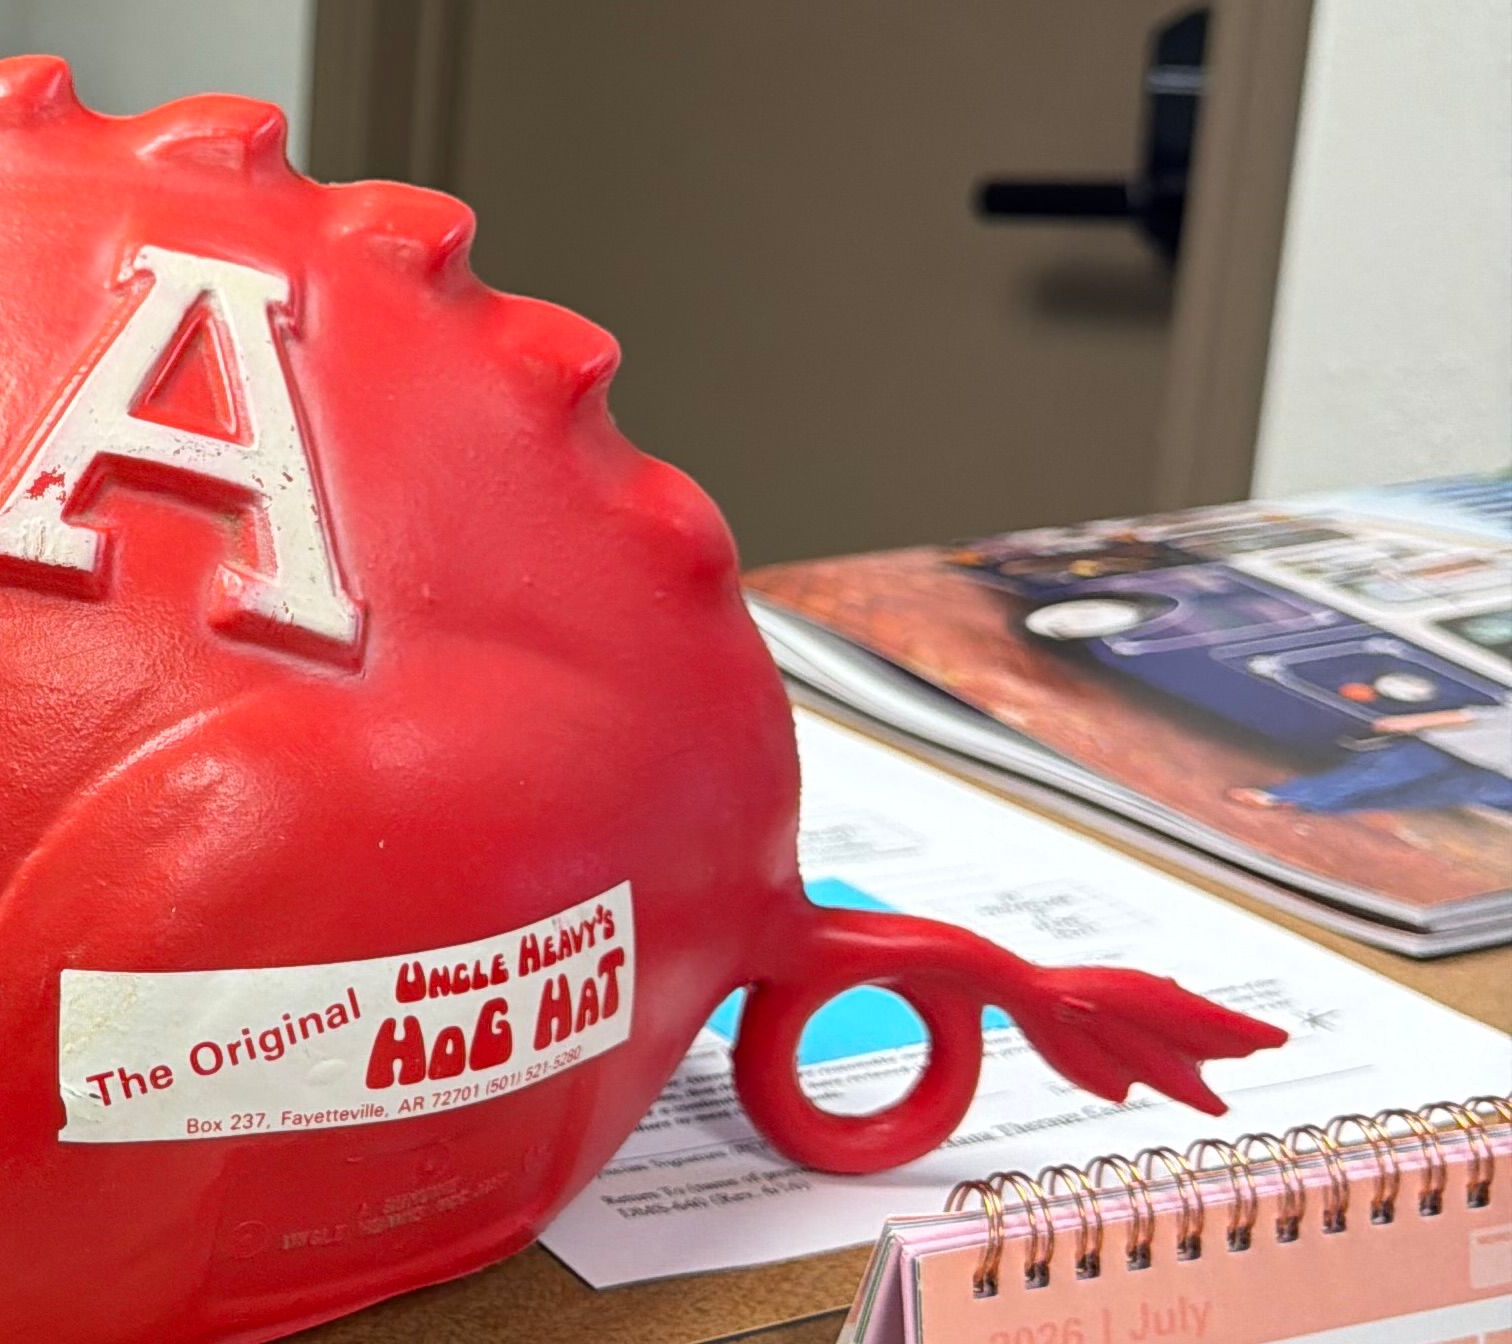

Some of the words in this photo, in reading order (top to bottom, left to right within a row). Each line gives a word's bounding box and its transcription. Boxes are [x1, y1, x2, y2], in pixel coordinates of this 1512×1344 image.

[395, 953, 509, 1003] UNCLE
[518, 904, 615, 977] HEAVY'S
[86, 1064, 174, 1106] The
[189, 987, 361, 1076] Original
[365, 997, 513, 1089] HOG
[533, 946, 625, 1051] HAT
[186, 1117, 223, 1134] Box
[230, 1112, 271, 1130] 237,
[280, 1103, 389, 1127] Fayetteville,
[397, 1096, 425, 1114] AR
[432, 1084, 479, 1108] 72701
[485, 1071, 521, 1096] (501)
[525, 1045, 583, 1083] 521-5280
[1128, 1295, 1211, 1342] July
